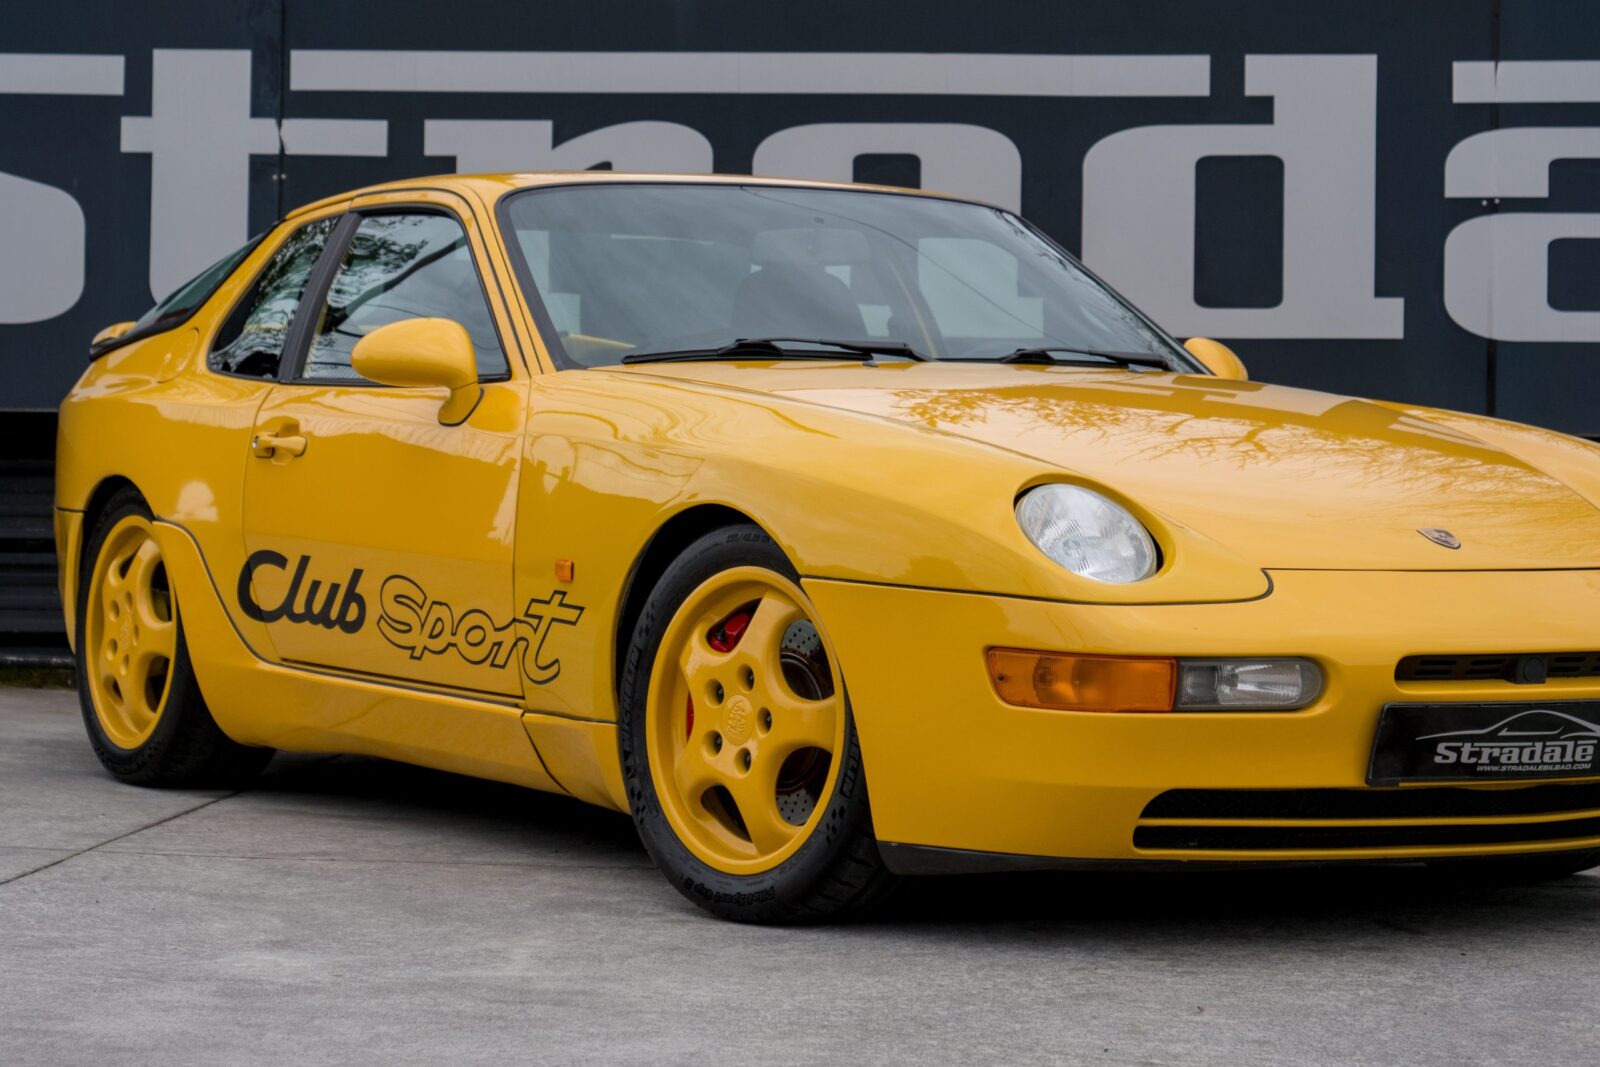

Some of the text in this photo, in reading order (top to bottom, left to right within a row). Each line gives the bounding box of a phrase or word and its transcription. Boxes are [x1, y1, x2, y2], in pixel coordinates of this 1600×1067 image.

[237, 550, 585, 685] Club Sport
[622, 644, 641, 752] MICHELIN
[1434, 740, 1597, 763] Stradale
